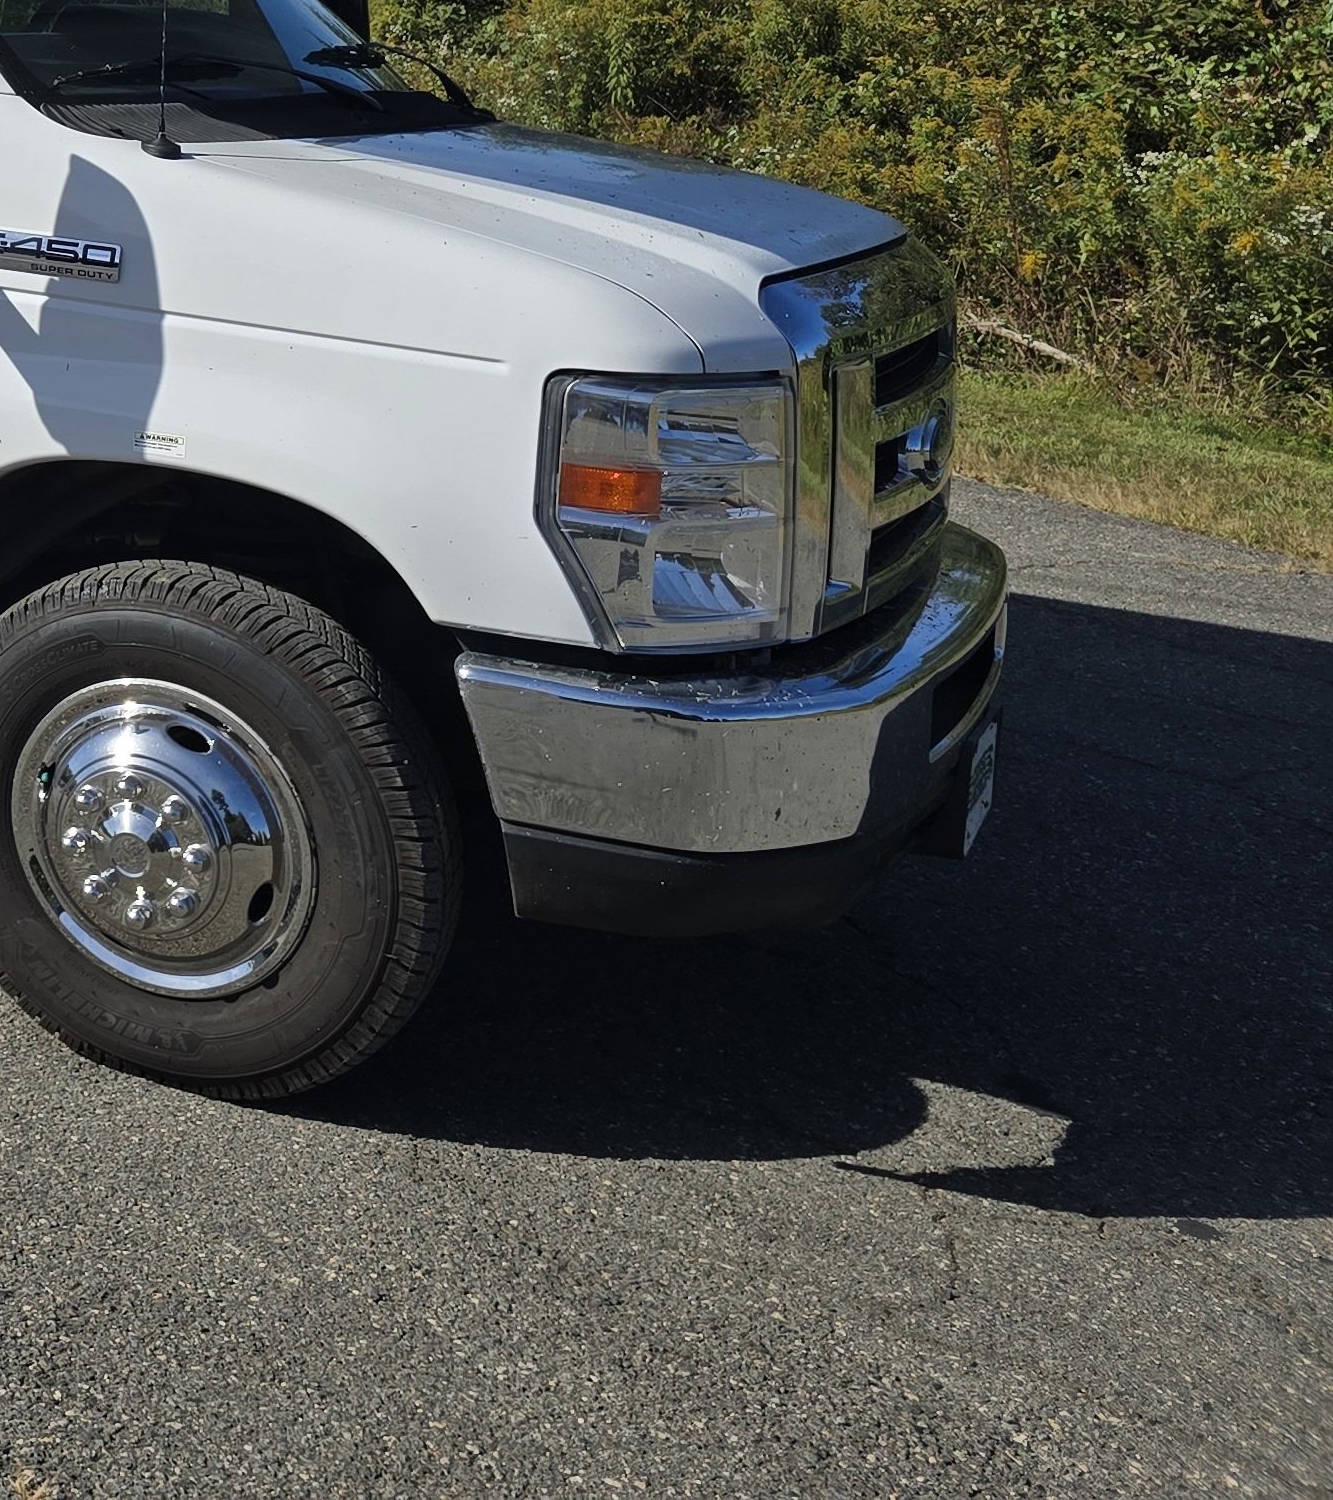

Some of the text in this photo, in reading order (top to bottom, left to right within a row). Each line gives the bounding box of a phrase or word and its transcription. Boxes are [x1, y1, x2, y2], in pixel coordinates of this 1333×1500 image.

[31, 263, 114, 280] SUPER DUTY
[145, 433, 179, 444] WARNING
[30, 960, 151, 1043] MICHELIN
